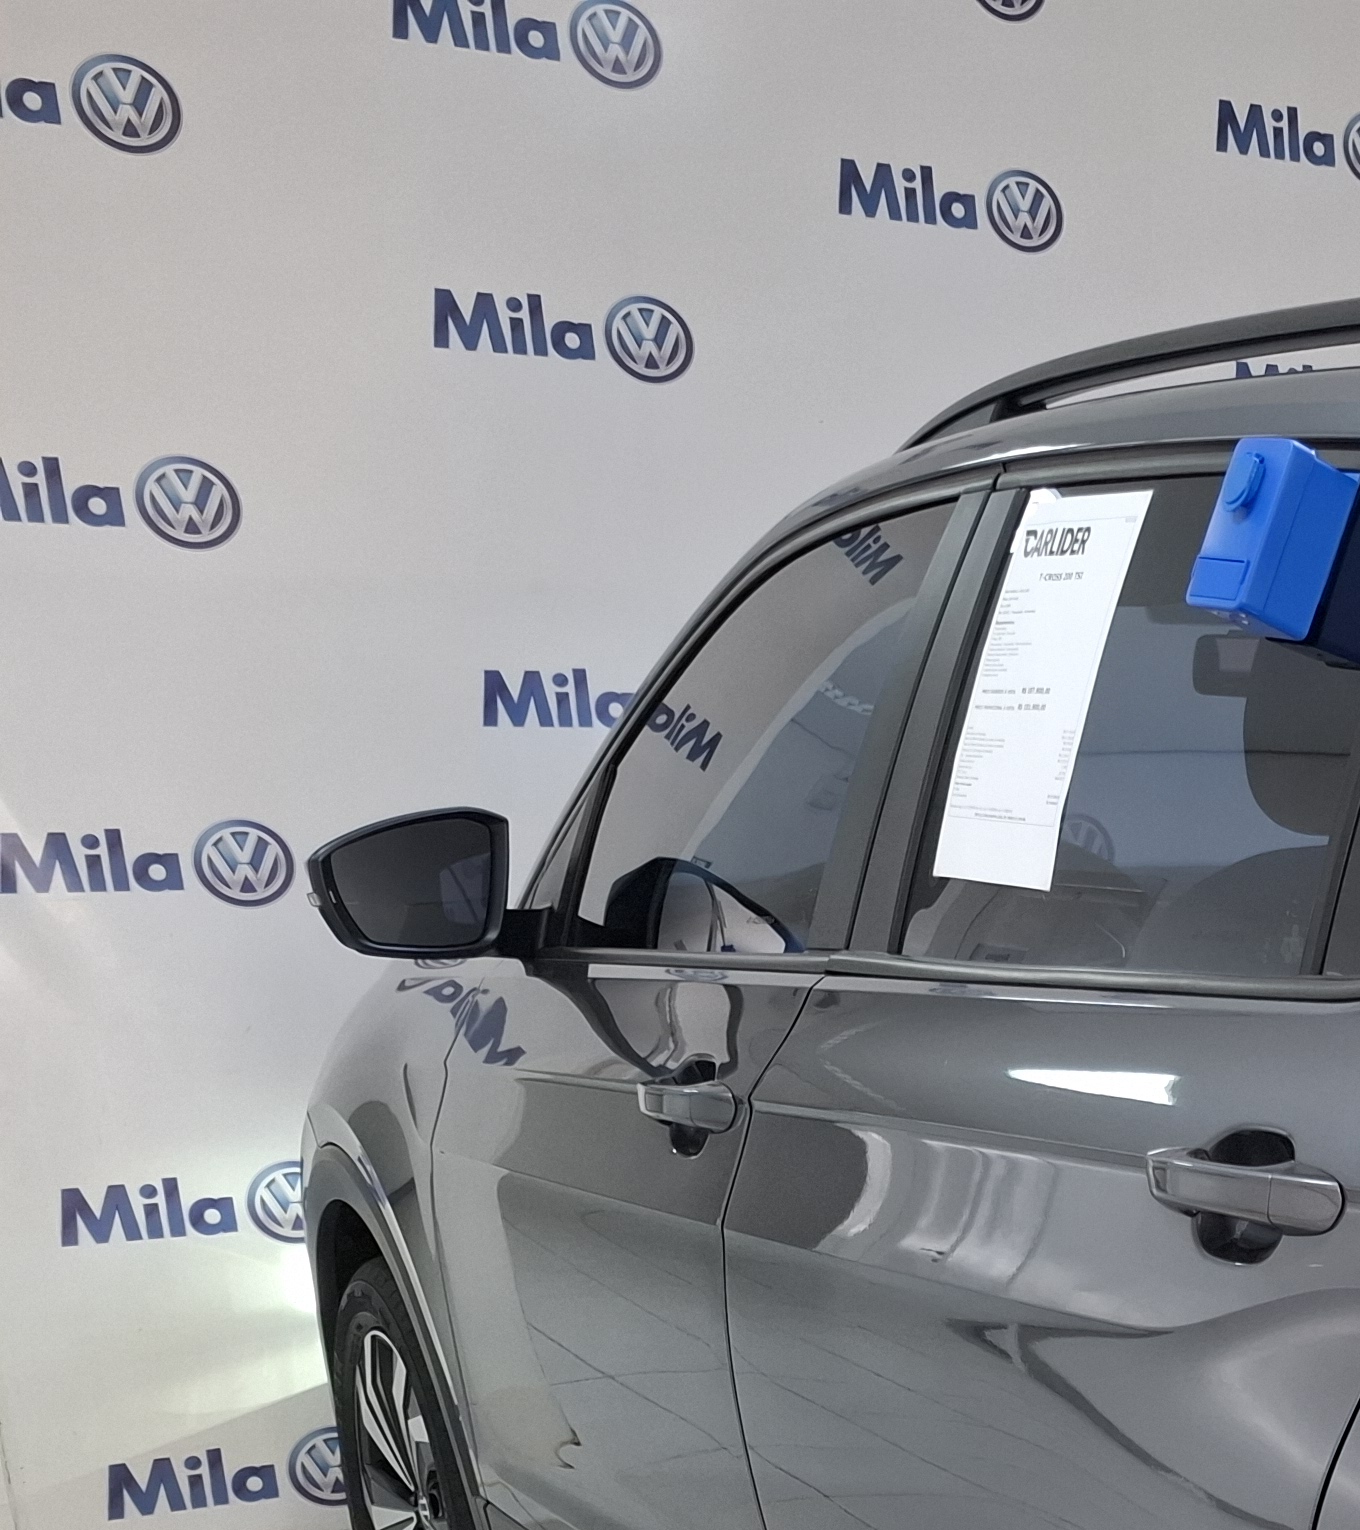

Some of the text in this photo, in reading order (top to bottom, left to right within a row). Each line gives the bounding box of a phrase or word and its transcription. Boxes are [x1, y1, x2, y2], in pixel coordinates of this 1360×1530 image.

[392, 0, 560, 61] Mila
[1216, 99, 1336, 167] Mila
[838, 158, 978, 230] Mila
[433, 288, 596, 361] Mila
[0, 456, 126, 527] ila
[1023, 526, 1092, 558] CARLIDER
[0, 829, 184, 894] Mila
[61, 1178, 238, 1247] Mila
[107, 1449, 279, 1521] Mila
